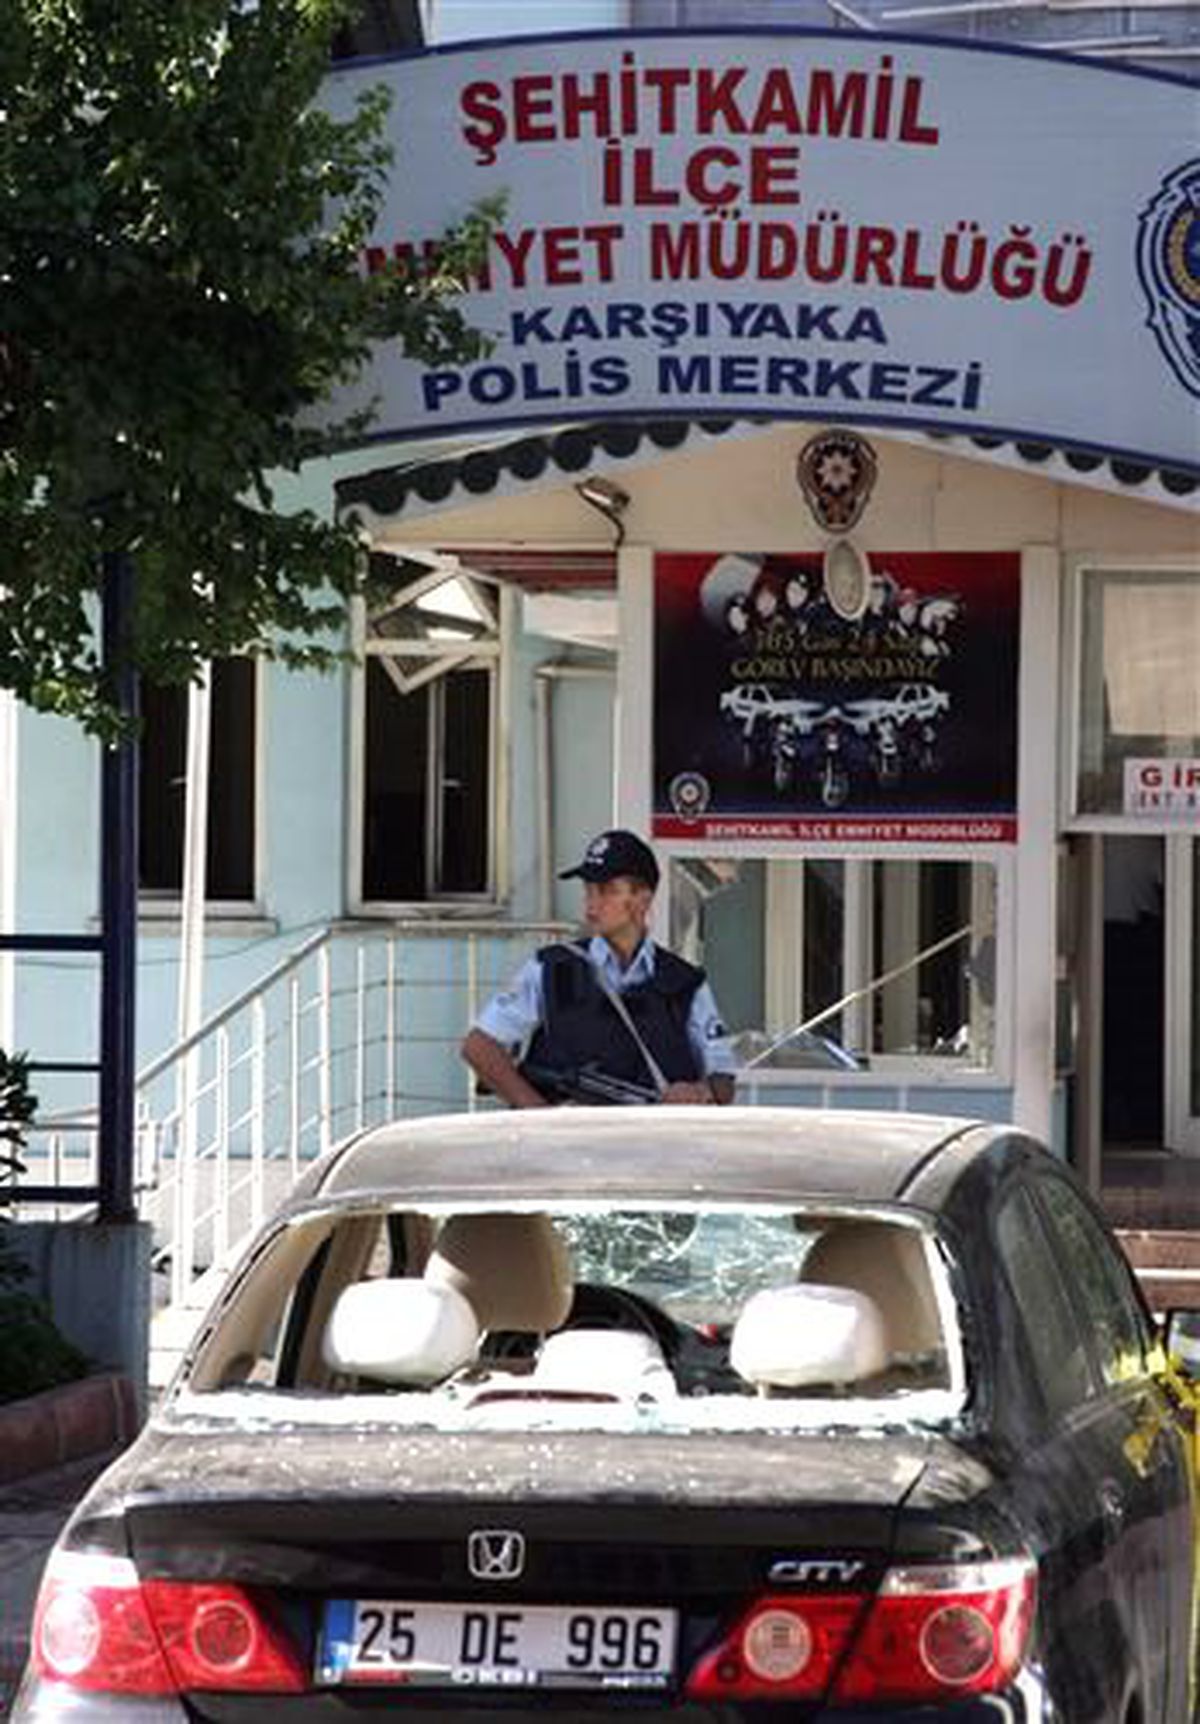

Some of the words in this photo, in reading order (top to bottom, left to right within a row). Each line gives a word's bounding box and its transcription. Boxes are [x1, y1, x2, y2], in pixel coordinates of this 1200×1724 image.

[460, 51, 939, 167] ŞEHİTKAMİL
[603, 138, 801, 216] İLÇE
[650, 206, 1092, 307] MÜDÜRLÜĞÜ
[510, 301, 888, 348] KARŞIYAKA
[421, 347, 630, 411] POLİS
[657, 355, 982, 410] MERKEZİ
[357, 1609, 416, 1664] 25
[459, 1612, 523, 1667] DE
[565, 1614, 664, 1670] 996
